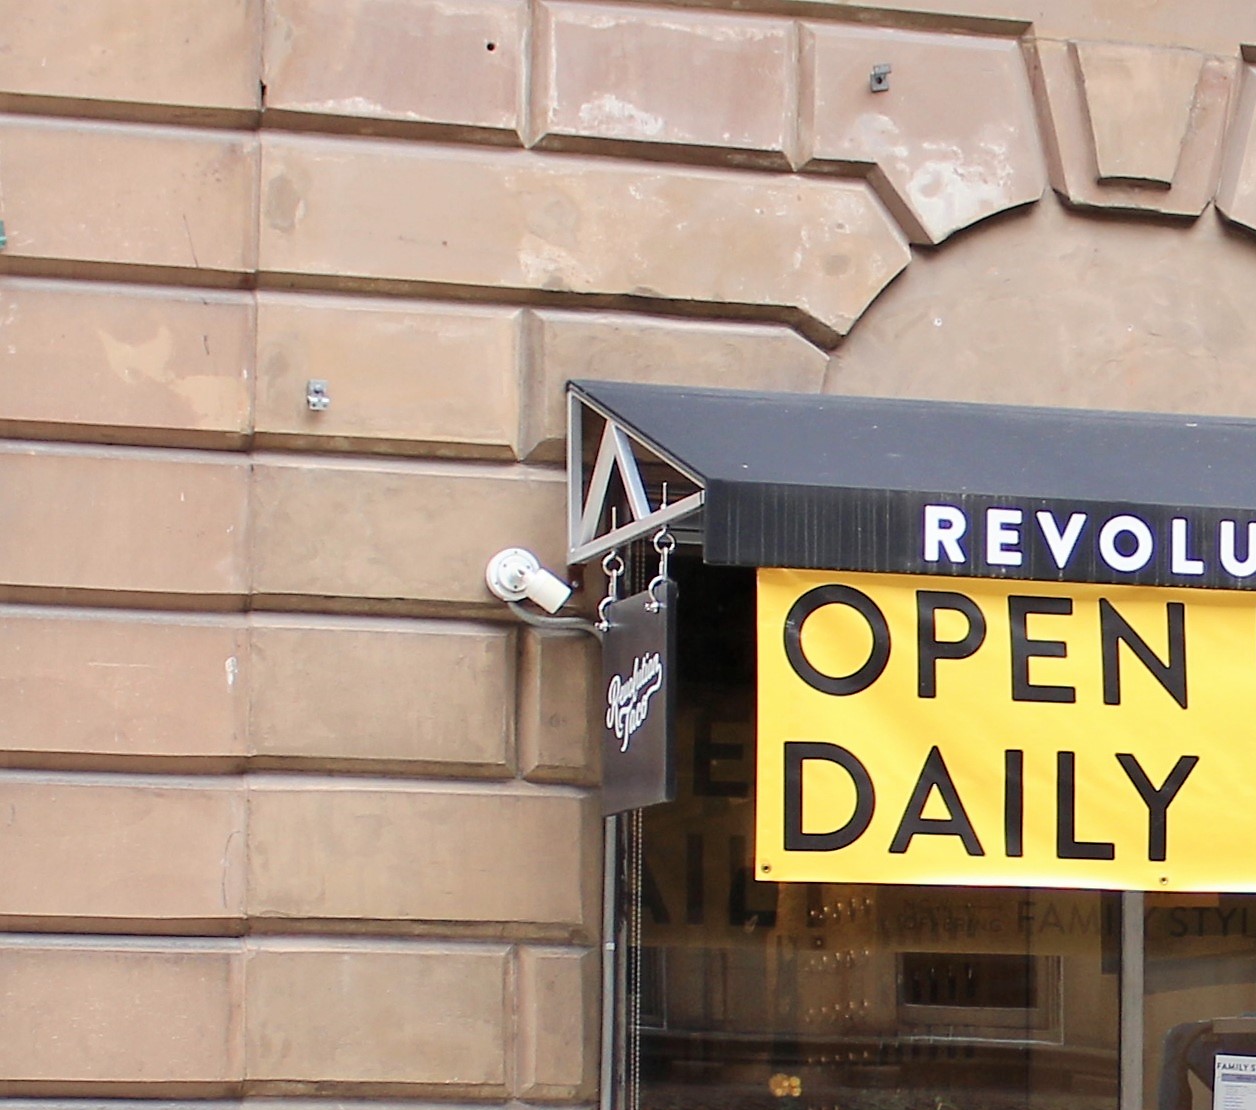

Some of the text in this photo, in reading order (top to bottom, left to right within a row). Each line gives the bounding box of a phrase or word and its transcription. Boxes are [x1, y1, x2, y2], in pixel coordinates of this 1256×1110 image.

[784, 584, 1189, 709] OPEN
[606, 652, 663, 739] Revolution
[617, 695, 648, 752] Taco
[784, 741, 1199, 861] DAILY
[1217, 1062, 1249, 1072] FAMILY
